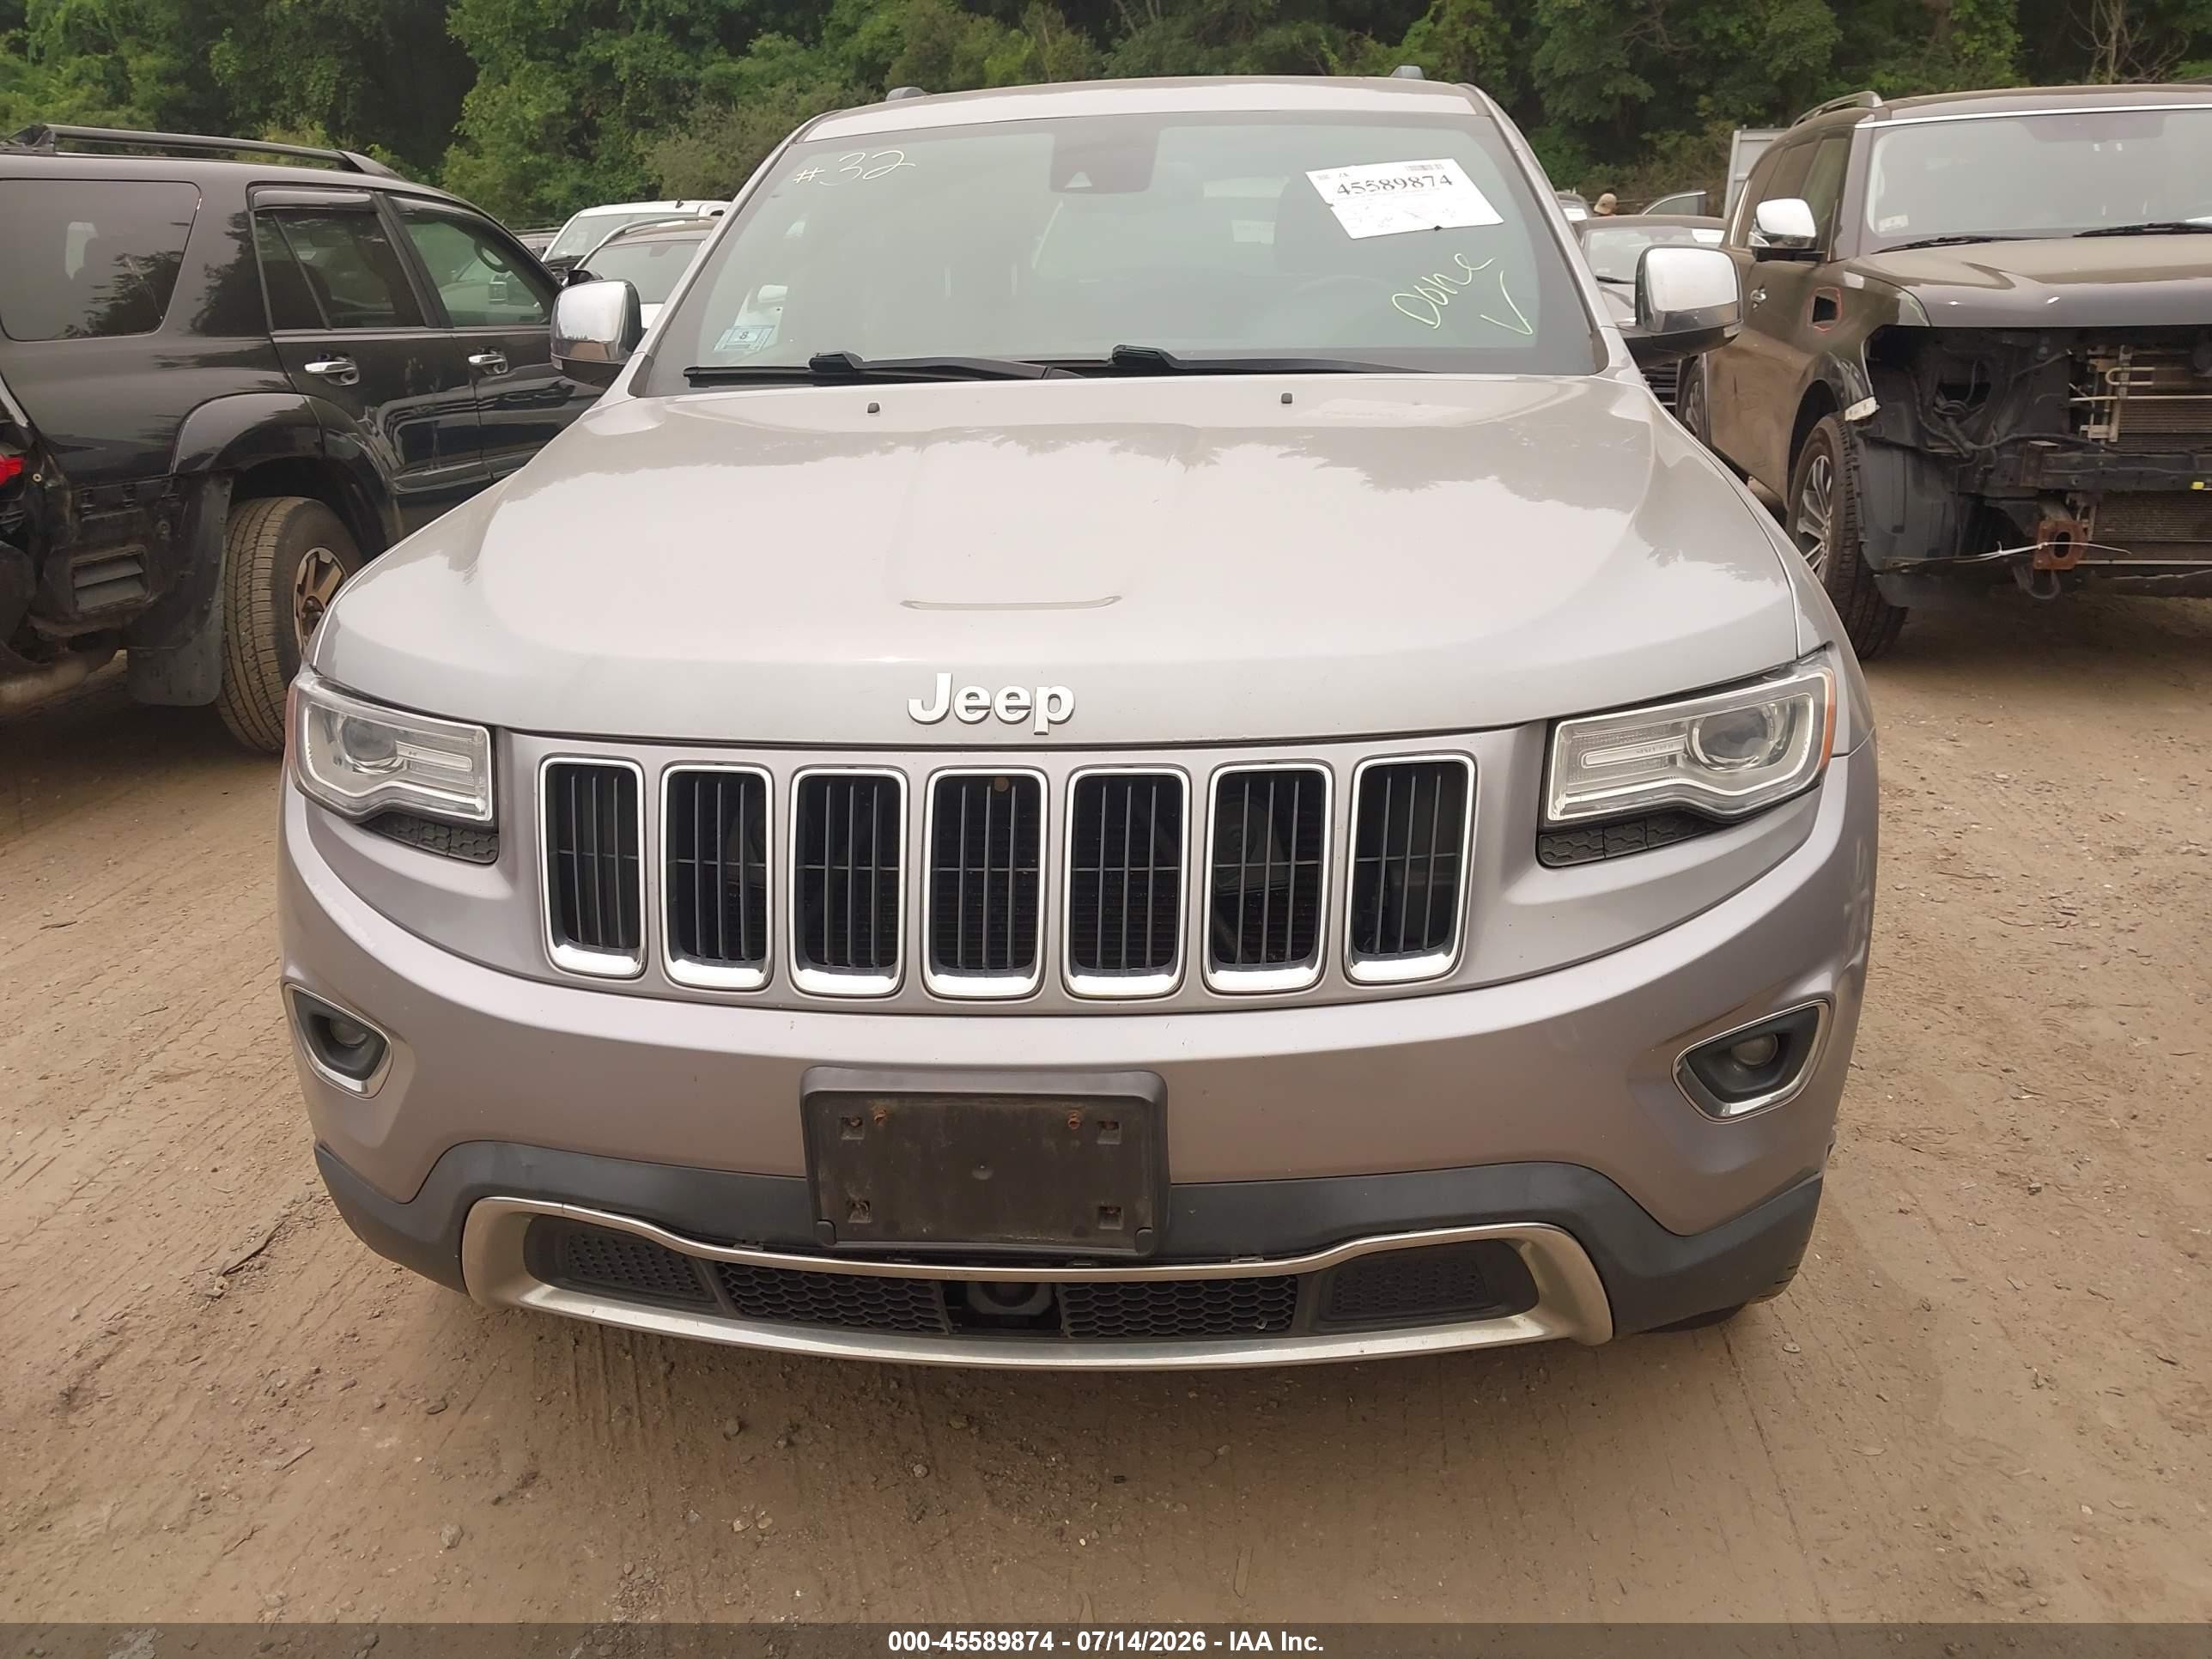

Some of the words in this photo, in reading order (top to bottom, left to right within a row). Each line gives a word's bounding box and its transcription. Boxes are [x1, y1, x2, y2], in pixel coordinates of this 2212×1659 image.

[793, 149, 917, 186] #32
[1336, 173, 1454, 196] 45589874
[907, 672, 1075, 736] Jeep
